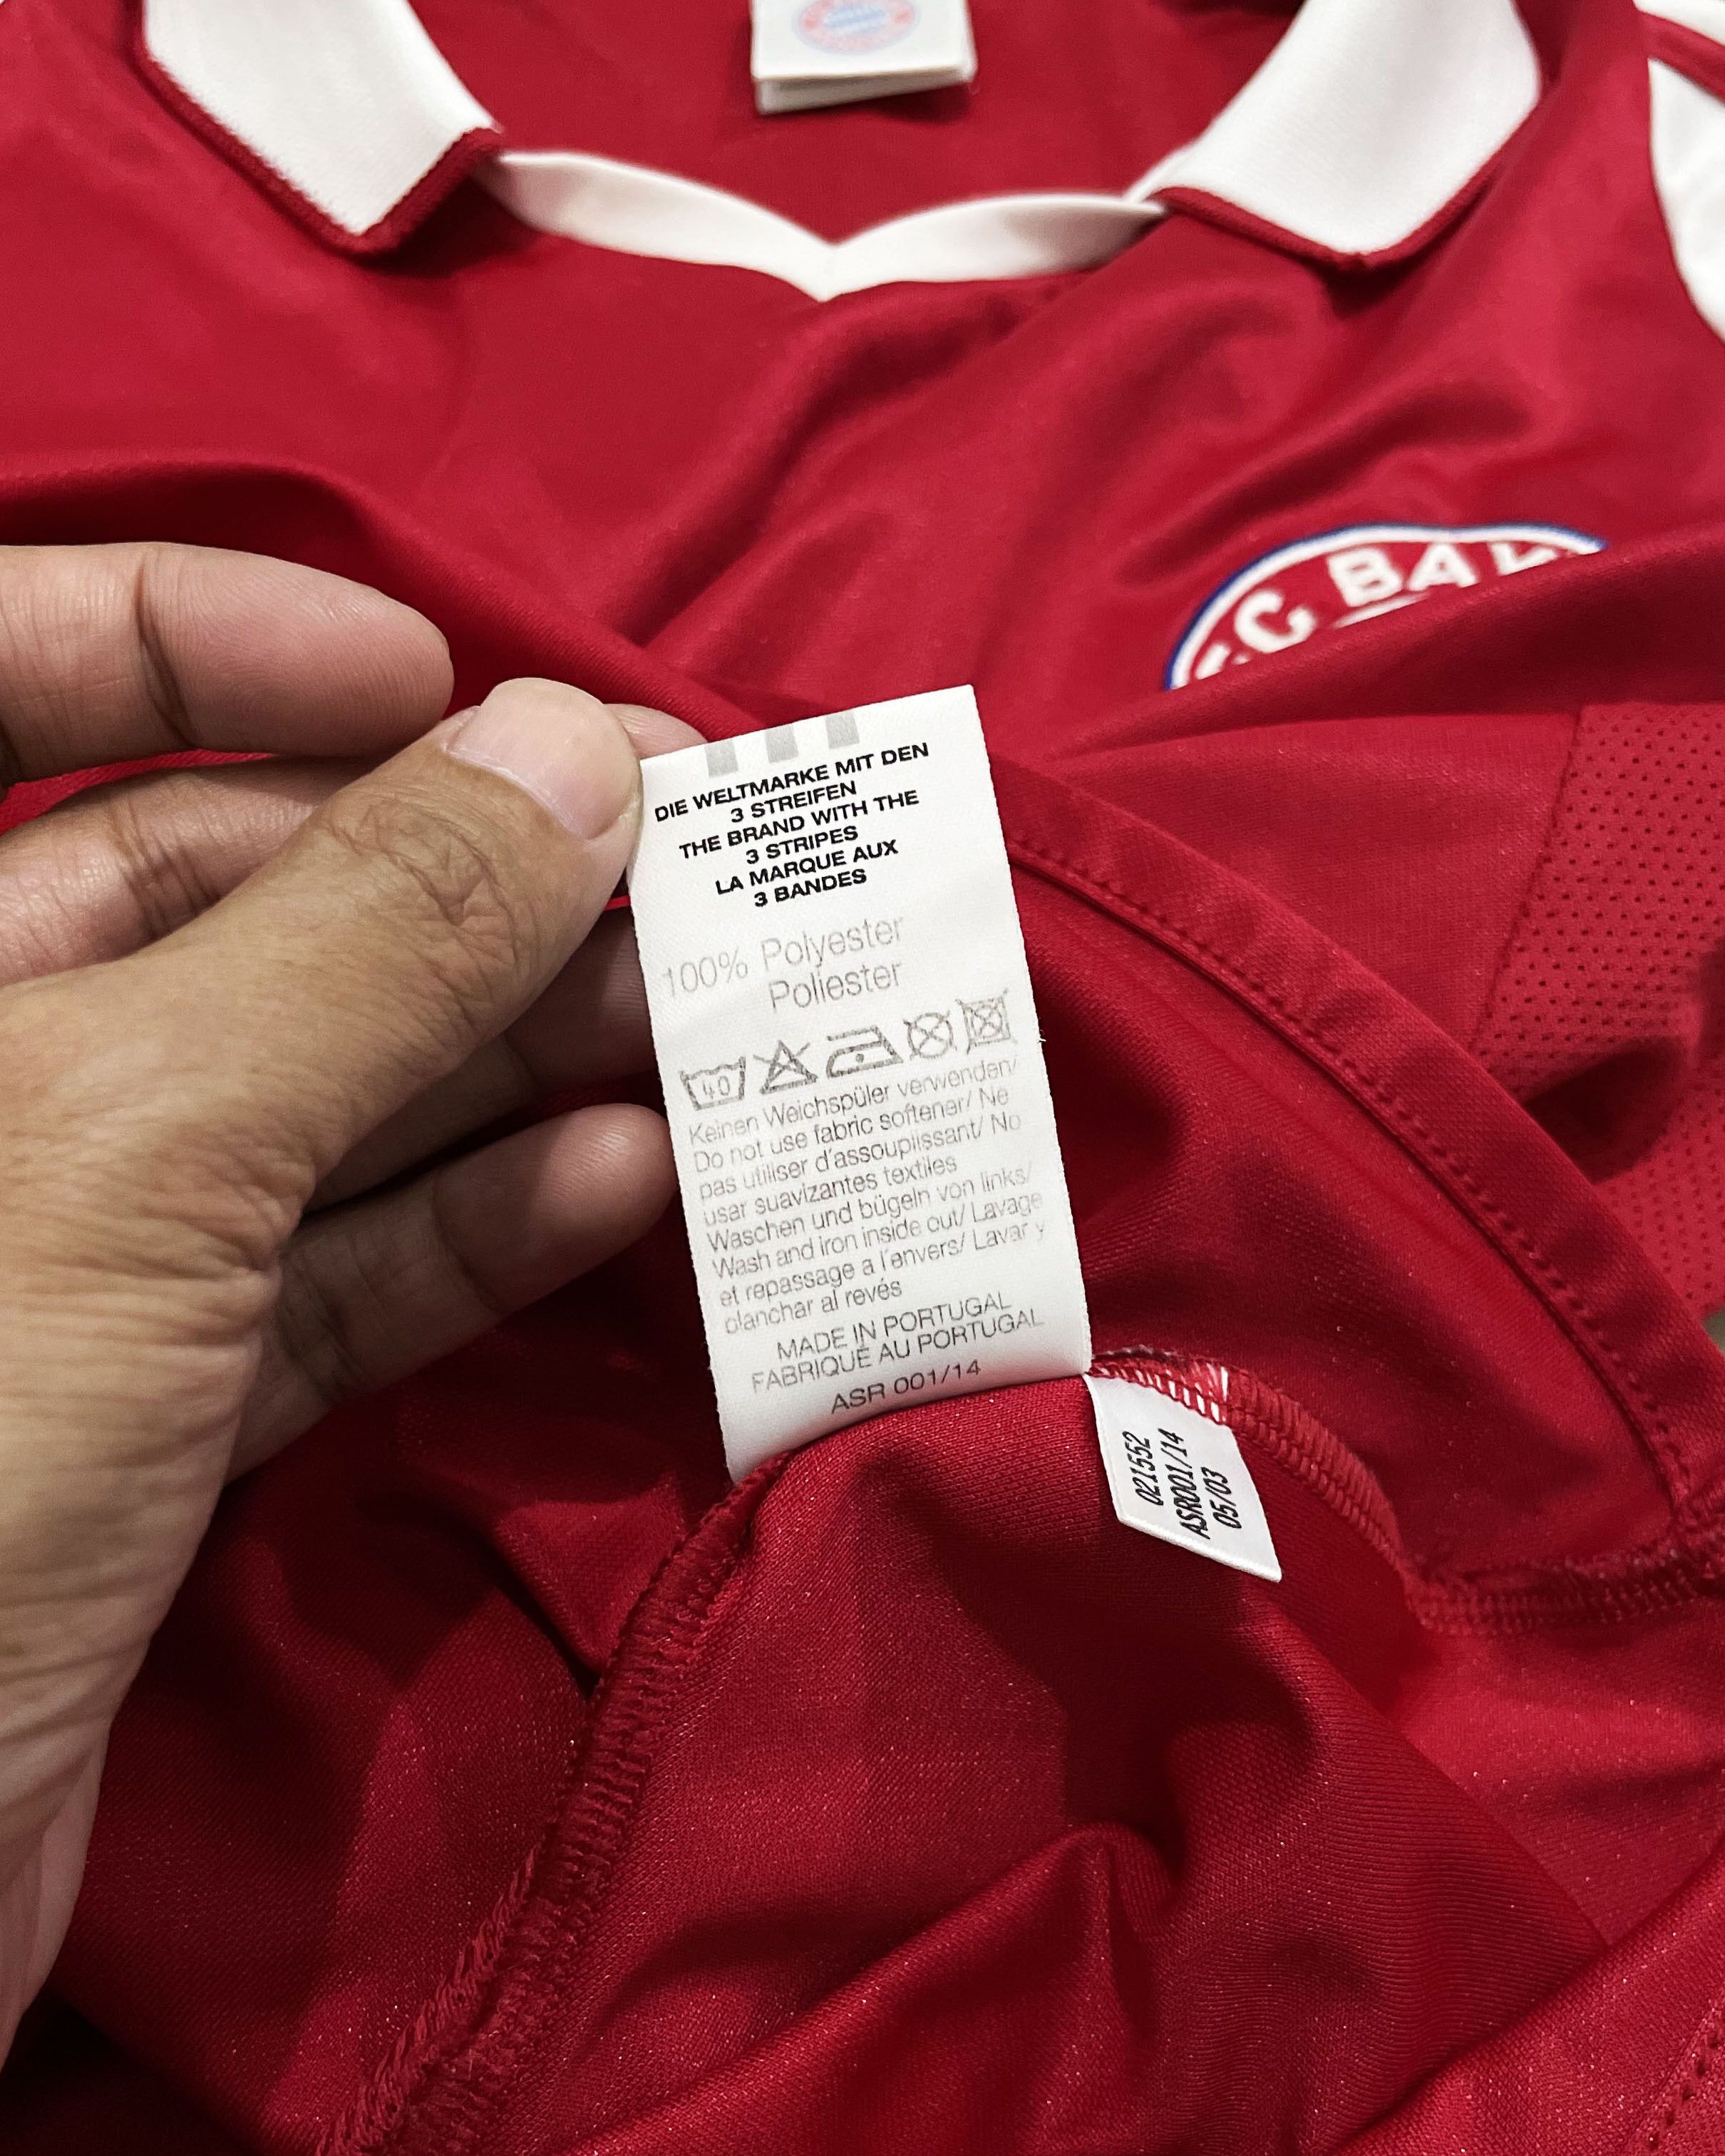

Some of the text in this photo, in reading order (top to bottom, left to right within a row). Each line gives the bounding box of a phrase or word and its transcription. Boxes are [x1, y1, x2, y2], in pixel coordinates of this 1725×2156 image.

[654, 742, 929, 822] DIE WELTMARKE MIT DEN
[731, 780, 856, 823] 3 STREIFEN
[679, 790, 920, 858] THE BRAND WITH THE
[746, 826, 858, 864] 3 STRIPES
[715, 839, 898, 895] LA MARQUE AUX
[754, 868, 867, 908] 3 BANDES
[661, 917, 903, 997] 100% Polyester
[768, 961, 902, 1013] Poliester
[689, 1055, 1016, 1146] Keinen Weichspüler verwenden/
[694, 1086, 1009, 1173] Do not use fabric softener/ Ne
[700, 1176, 737, 1201] pas
[743, 1159, 808, 1189] utiliser
[991, 1112, 1021, 1134] No
[704, 1155, 958, 1227] usar suavizantes textiles
[706, 1161, 1032, 1253] Waschen und bügeln von links/
[712, 1192, 1043, 1280] Wash and iron inside out/ Lavage
[720, 1285, 740, 1308] et
[746, 1263, 855, 1302] repassage
[973, 1222, 1029, 1251] Lavar
[820, 1288, 839, 1313] al
[845, 1278, 902, 1308] revés
[751, 1308, 1045, 1394] FABRIQUE AU PORTUGAL
[777, 1291, 1011, 1361] MADE IN PORTUGAL
[831, 1359, 982, 1415] ASR 001/14
[1122, 1430, 1164, 1506] 021552
[1158, 1428, 1210, 1539] ASR001/14
[1201, 1466, 1242, 1529] 05/03
